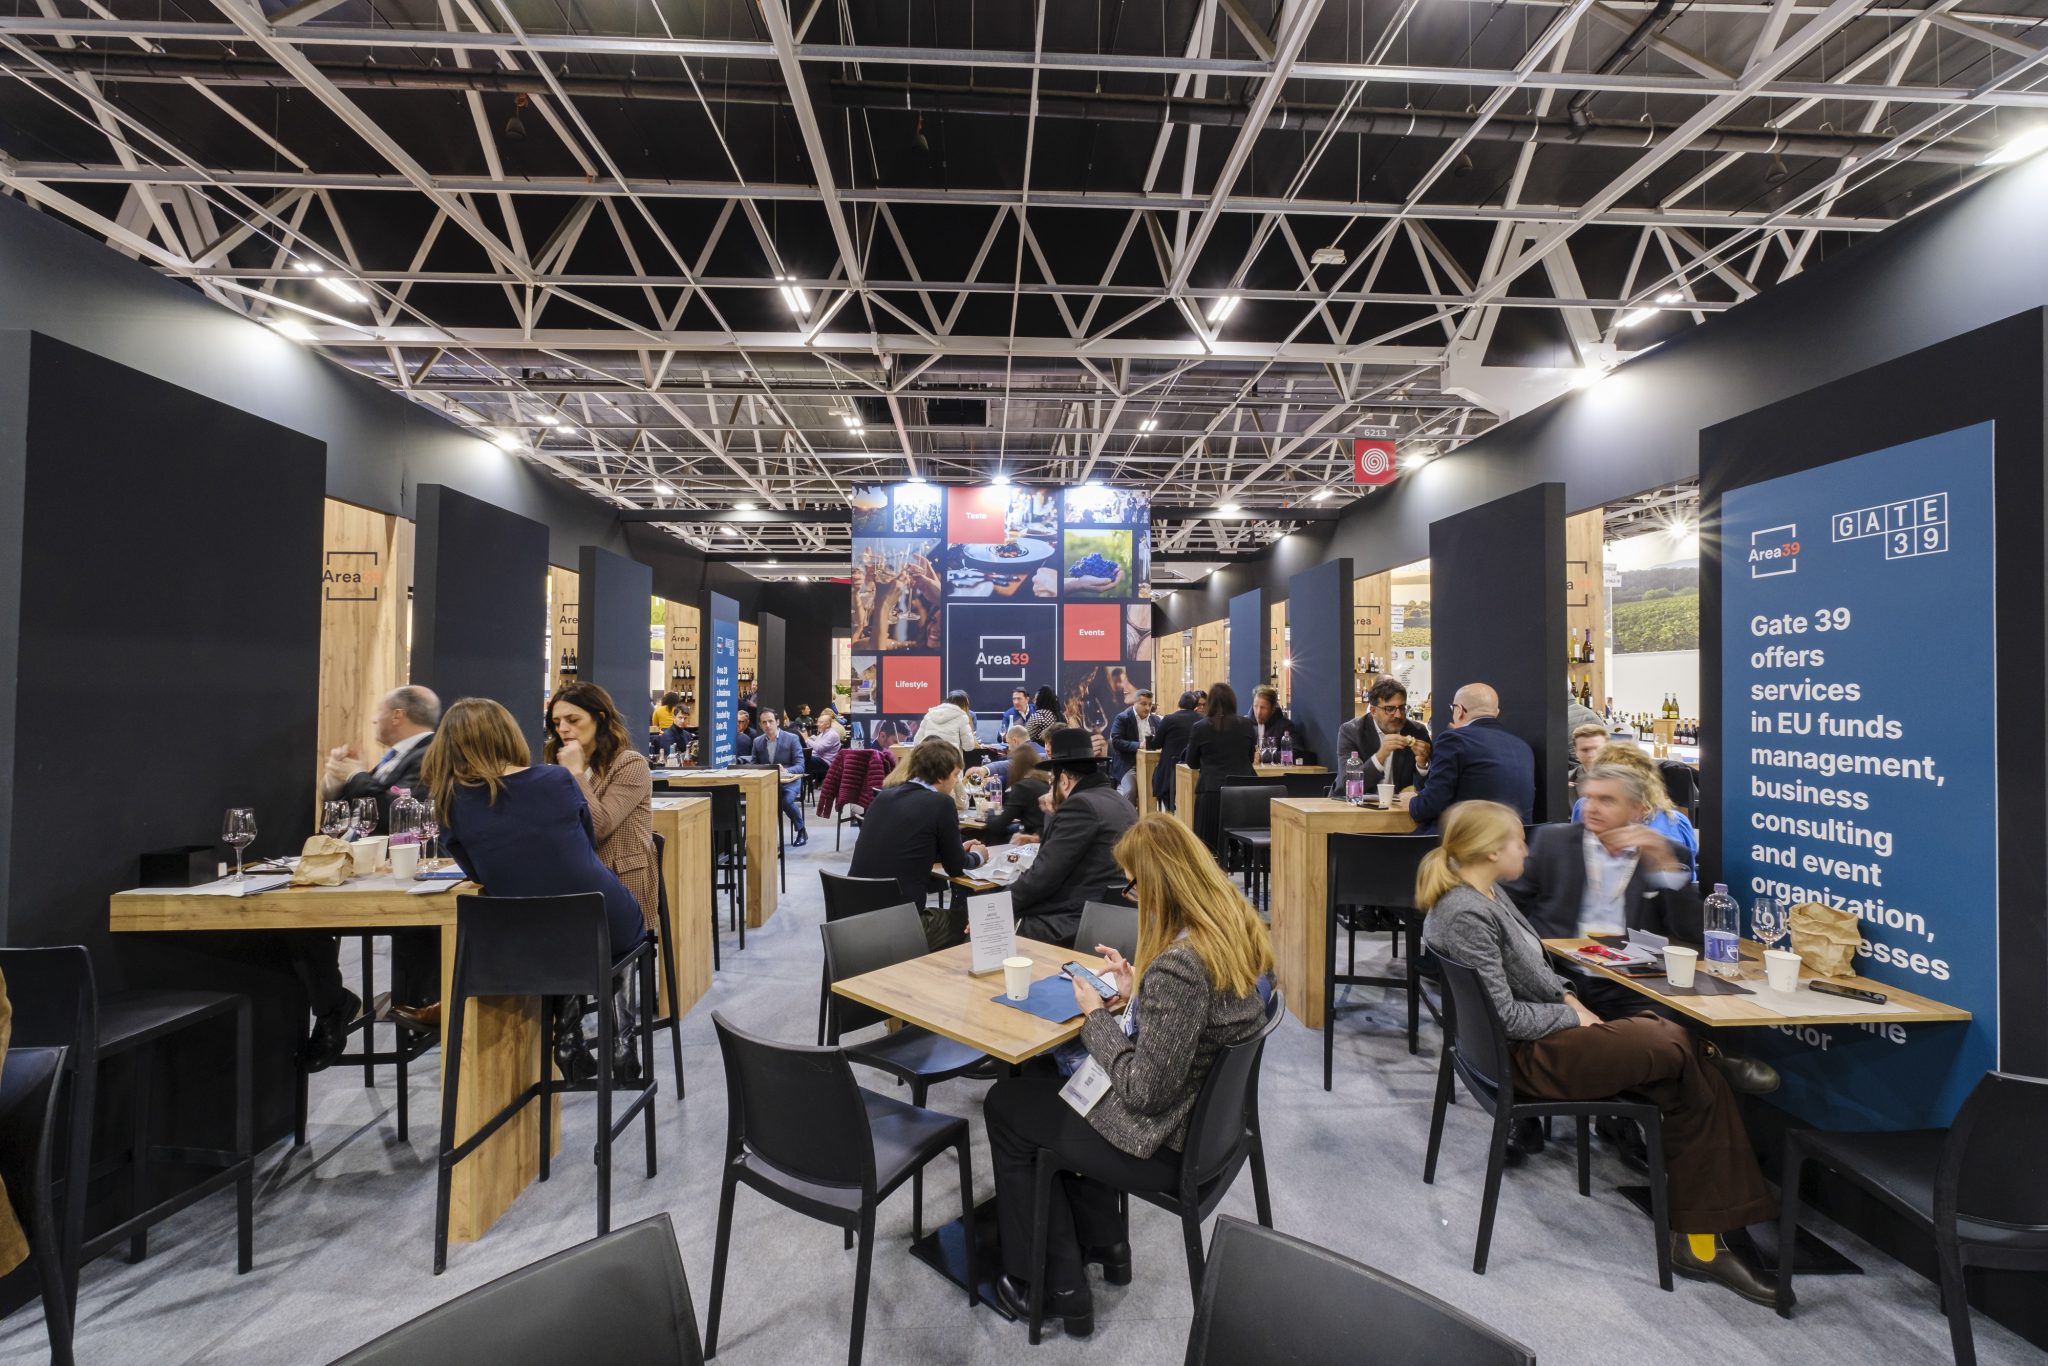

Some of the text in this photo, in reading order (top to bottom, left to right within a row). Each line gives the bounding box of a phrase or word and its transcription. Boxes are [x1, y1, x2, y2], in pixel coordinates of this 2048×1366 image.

[1364, 428, 1387, 437] 6213
[1838, 499, 1938, 537] GATE
[1748, 541, 1801, 563] Area39
[1893, 527, 1939, 554] 39
[1751, 607, 1851, 636] Gate 39
[976, 652, 1030, 665] Area39
[1751, 646, 1825, 668] offers
[895, 680, 929, 689] Lifestyle
[1751, 677, 1861, 702] services
[1752, 711, 1903, 740] in EU funds
[1751, 748, 1945, 787] management,
[1751, 776, 1869, 811] business
[1751, 812, 1893, 857] consulting
[1751, 844, 1882, 887] and event
[1751, 876, 1936, 943] organization,
